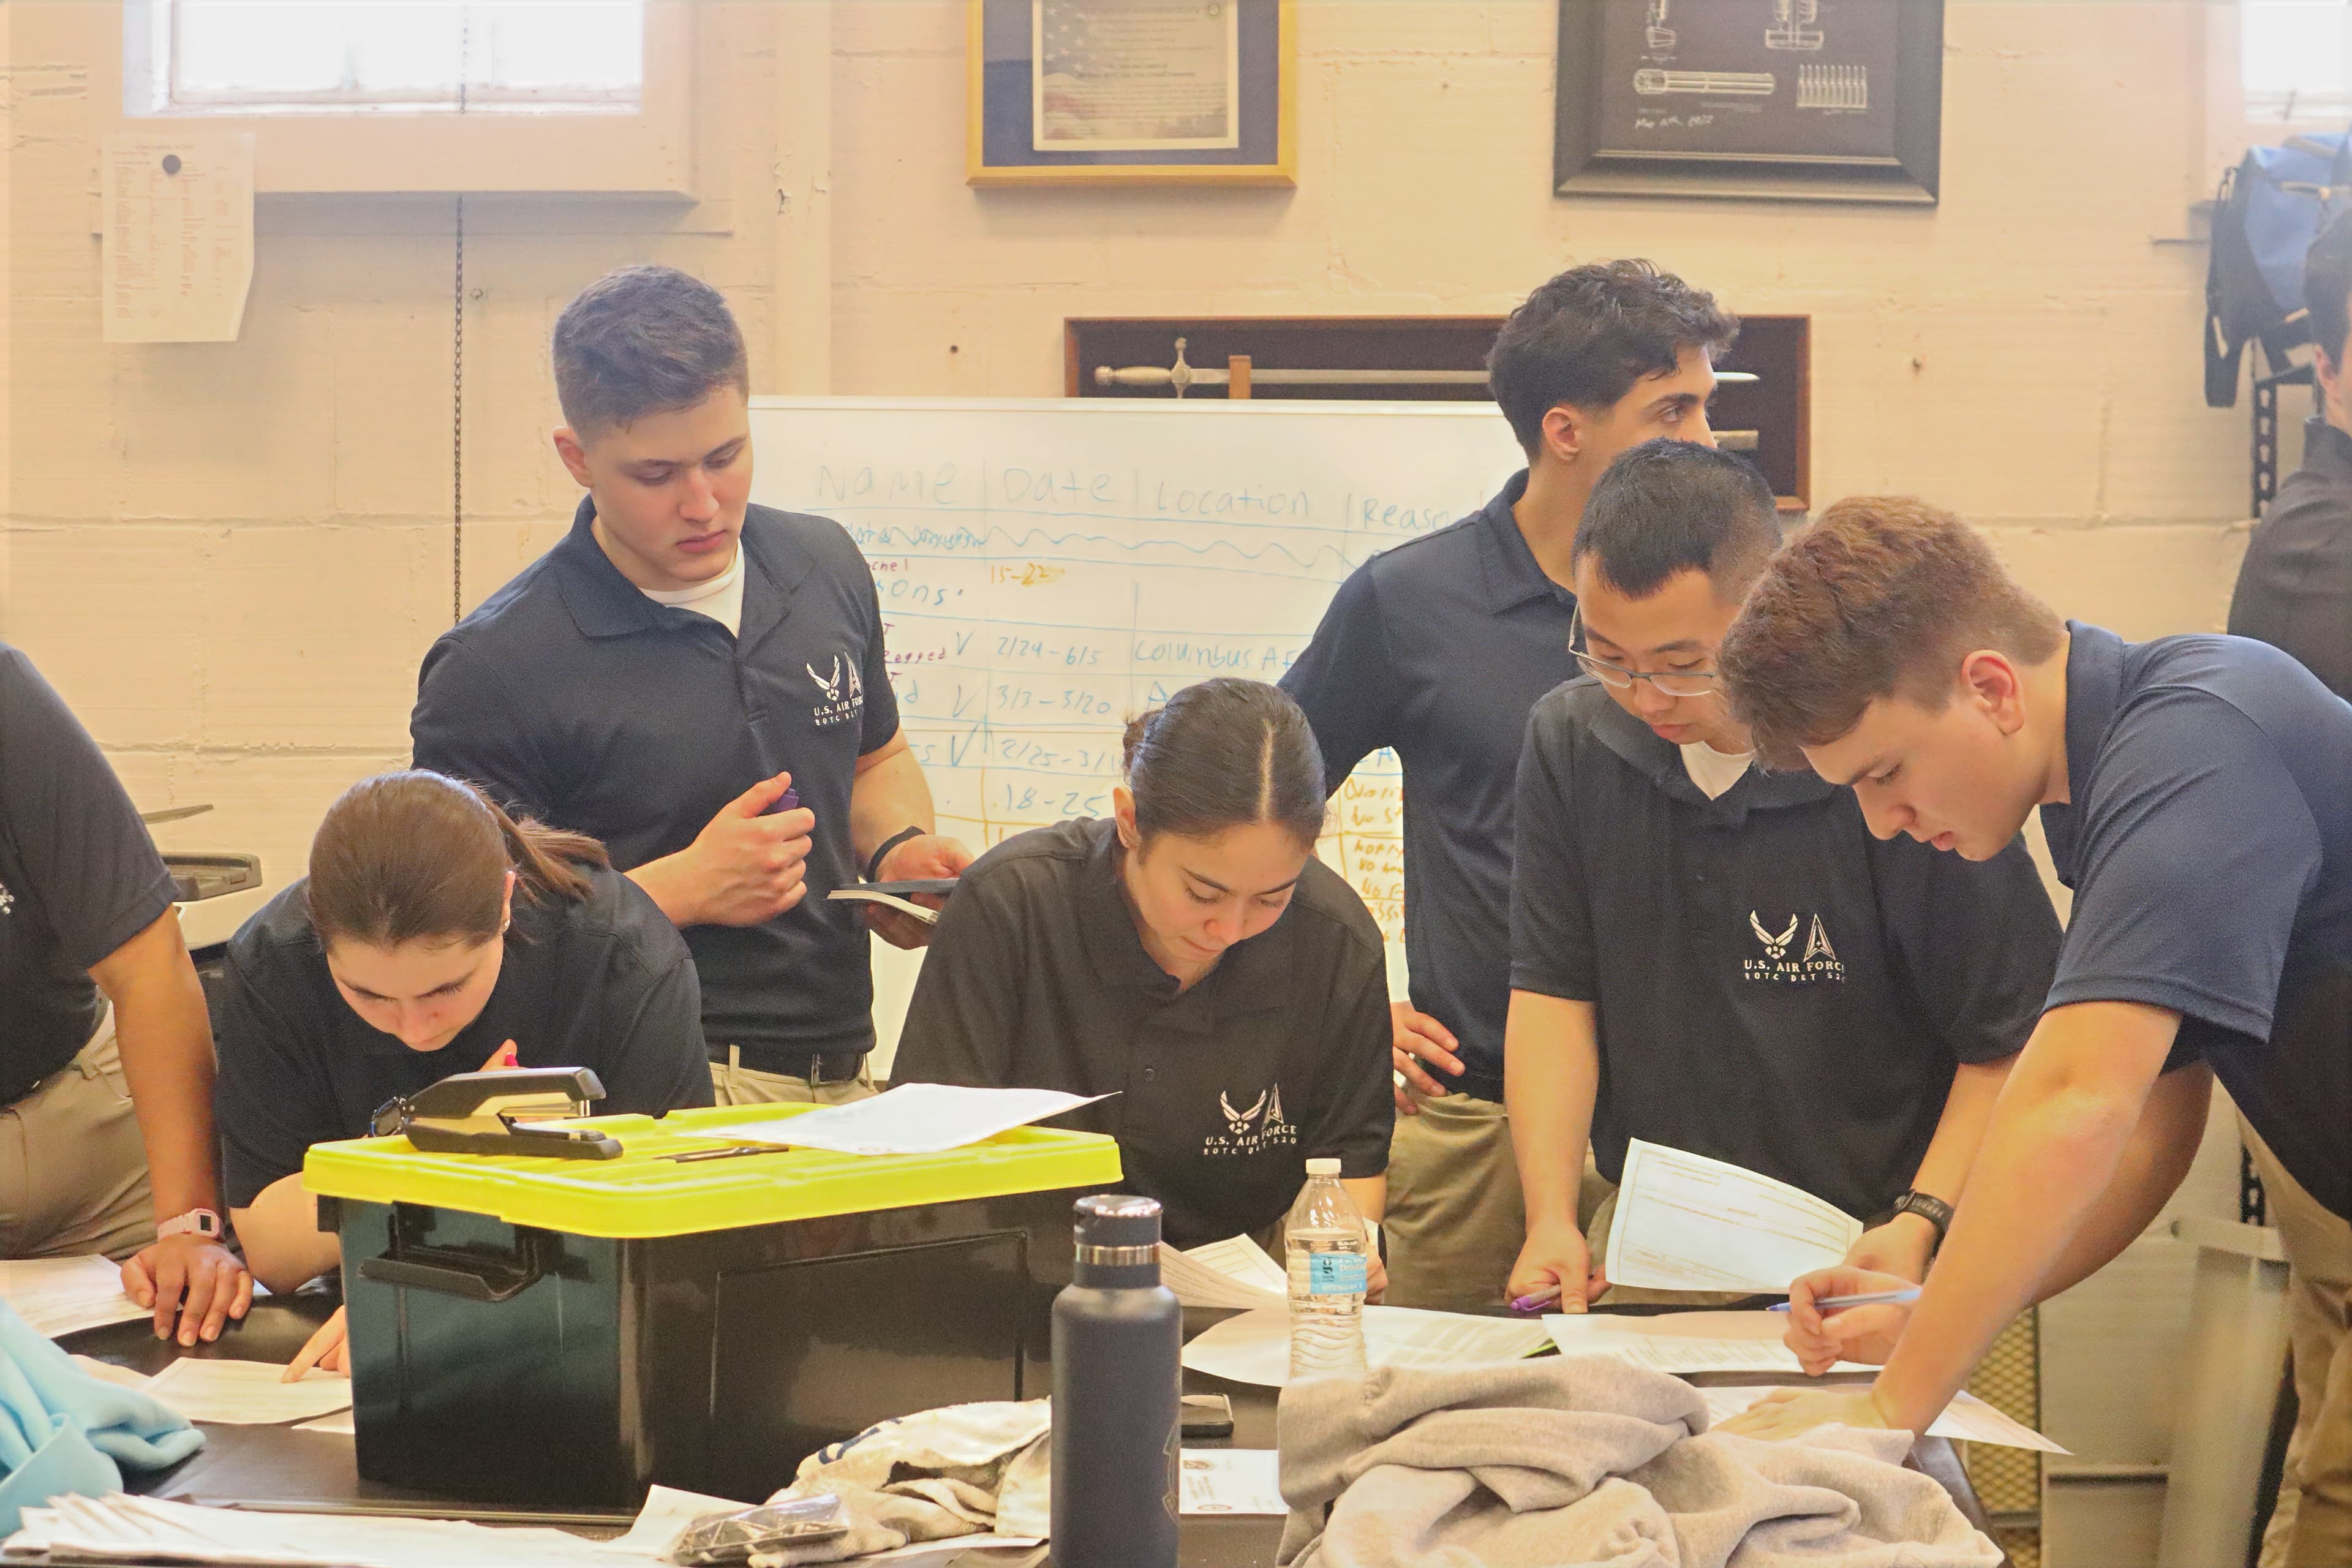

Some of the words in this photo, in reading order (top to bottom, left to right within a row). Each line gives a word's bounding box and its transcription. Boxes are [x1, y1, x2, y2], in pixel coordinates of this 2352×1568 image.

[818, 462, 957, 505] Name
[1003, 467, 1117, 503] Date
[1157, 480, 1308, 518] Location
[1363, 497, 1451, 530] Reaso
[1134, 639, 1251, 669] Columbus
[813, 706, 833, 716] U.S.
[836, 701, 850, 712] AIR
[815, 715, 840, 726] ROTC
[1744, 960, 1770, 970] U.S.
[1776, 962, 1800, 973] AIR
[1745, 972, 1779, 981] ROTC
[1791, 973, 1816, 982] DET
[1205, 1136, 1230, 1146] U.S.
[1236, 1135, 1258, 1147] AIR
[1261, 1125, 1297, 1140] FORCE
[1273, 1136, 1297, 1144] 520
